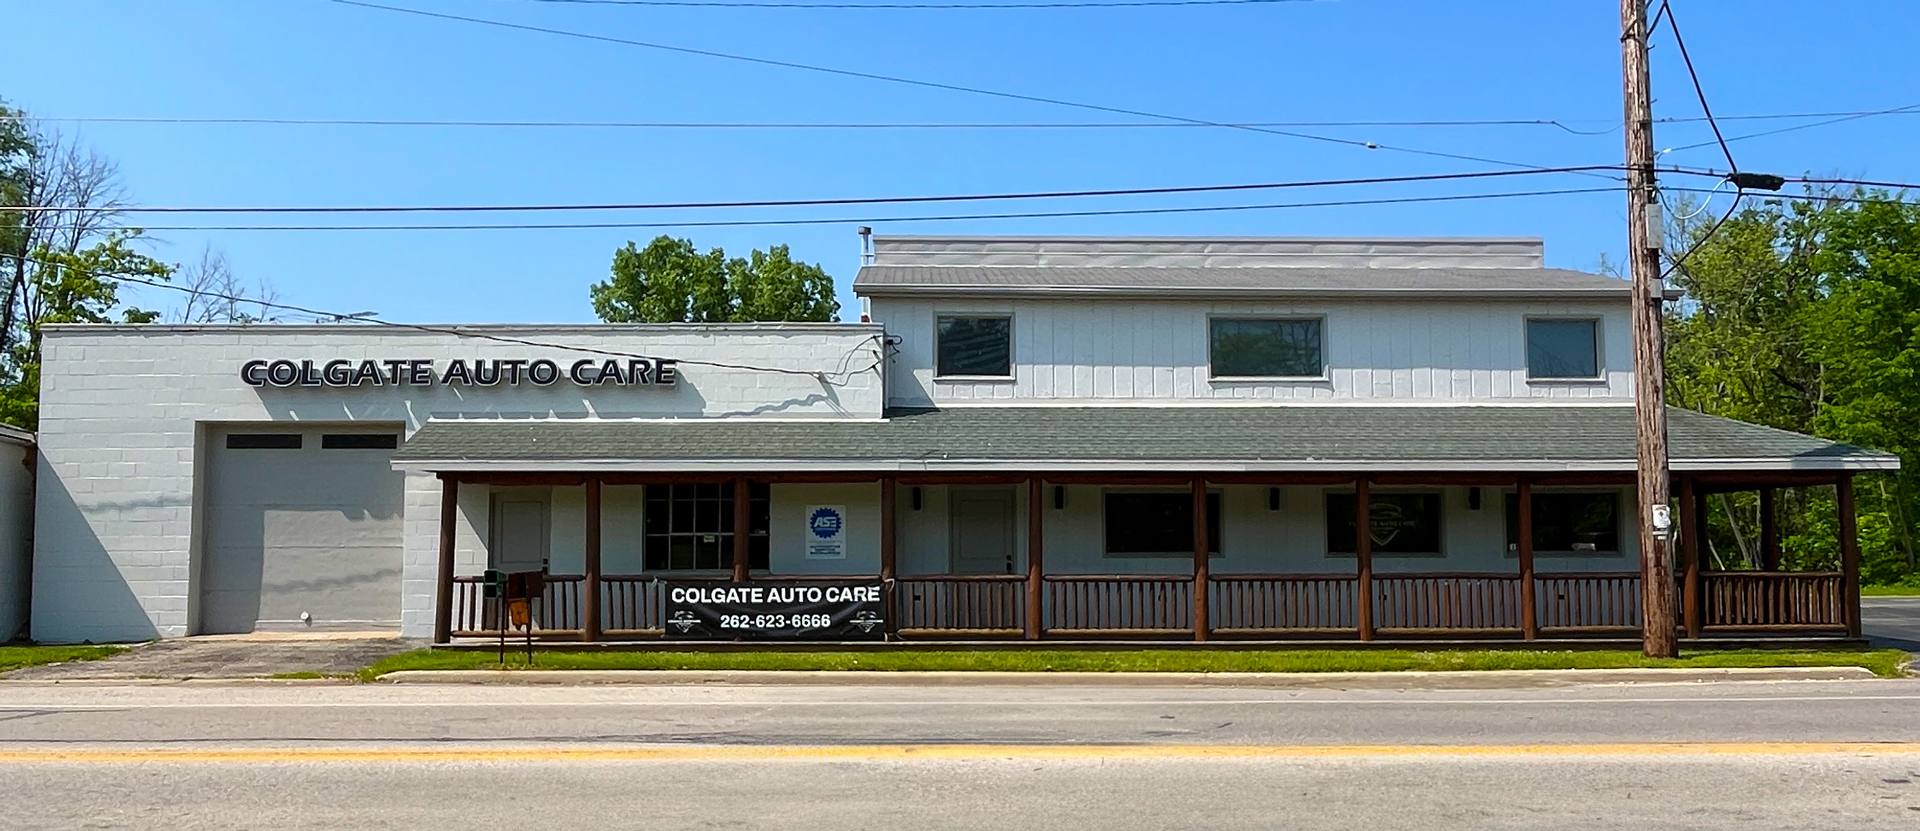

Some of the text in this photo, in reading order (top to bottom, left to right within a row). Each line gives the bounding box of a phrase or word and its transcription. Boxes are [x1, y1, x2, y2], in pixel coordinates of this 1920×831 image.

[240, 359, 678, 388] COLGATE AUTO CARE
[813, 516, 837, 527] ASE
[671, 586, 880, 603] COLGATE AUTO CARE
[720, 614, 831, 628] 262-623-6666
